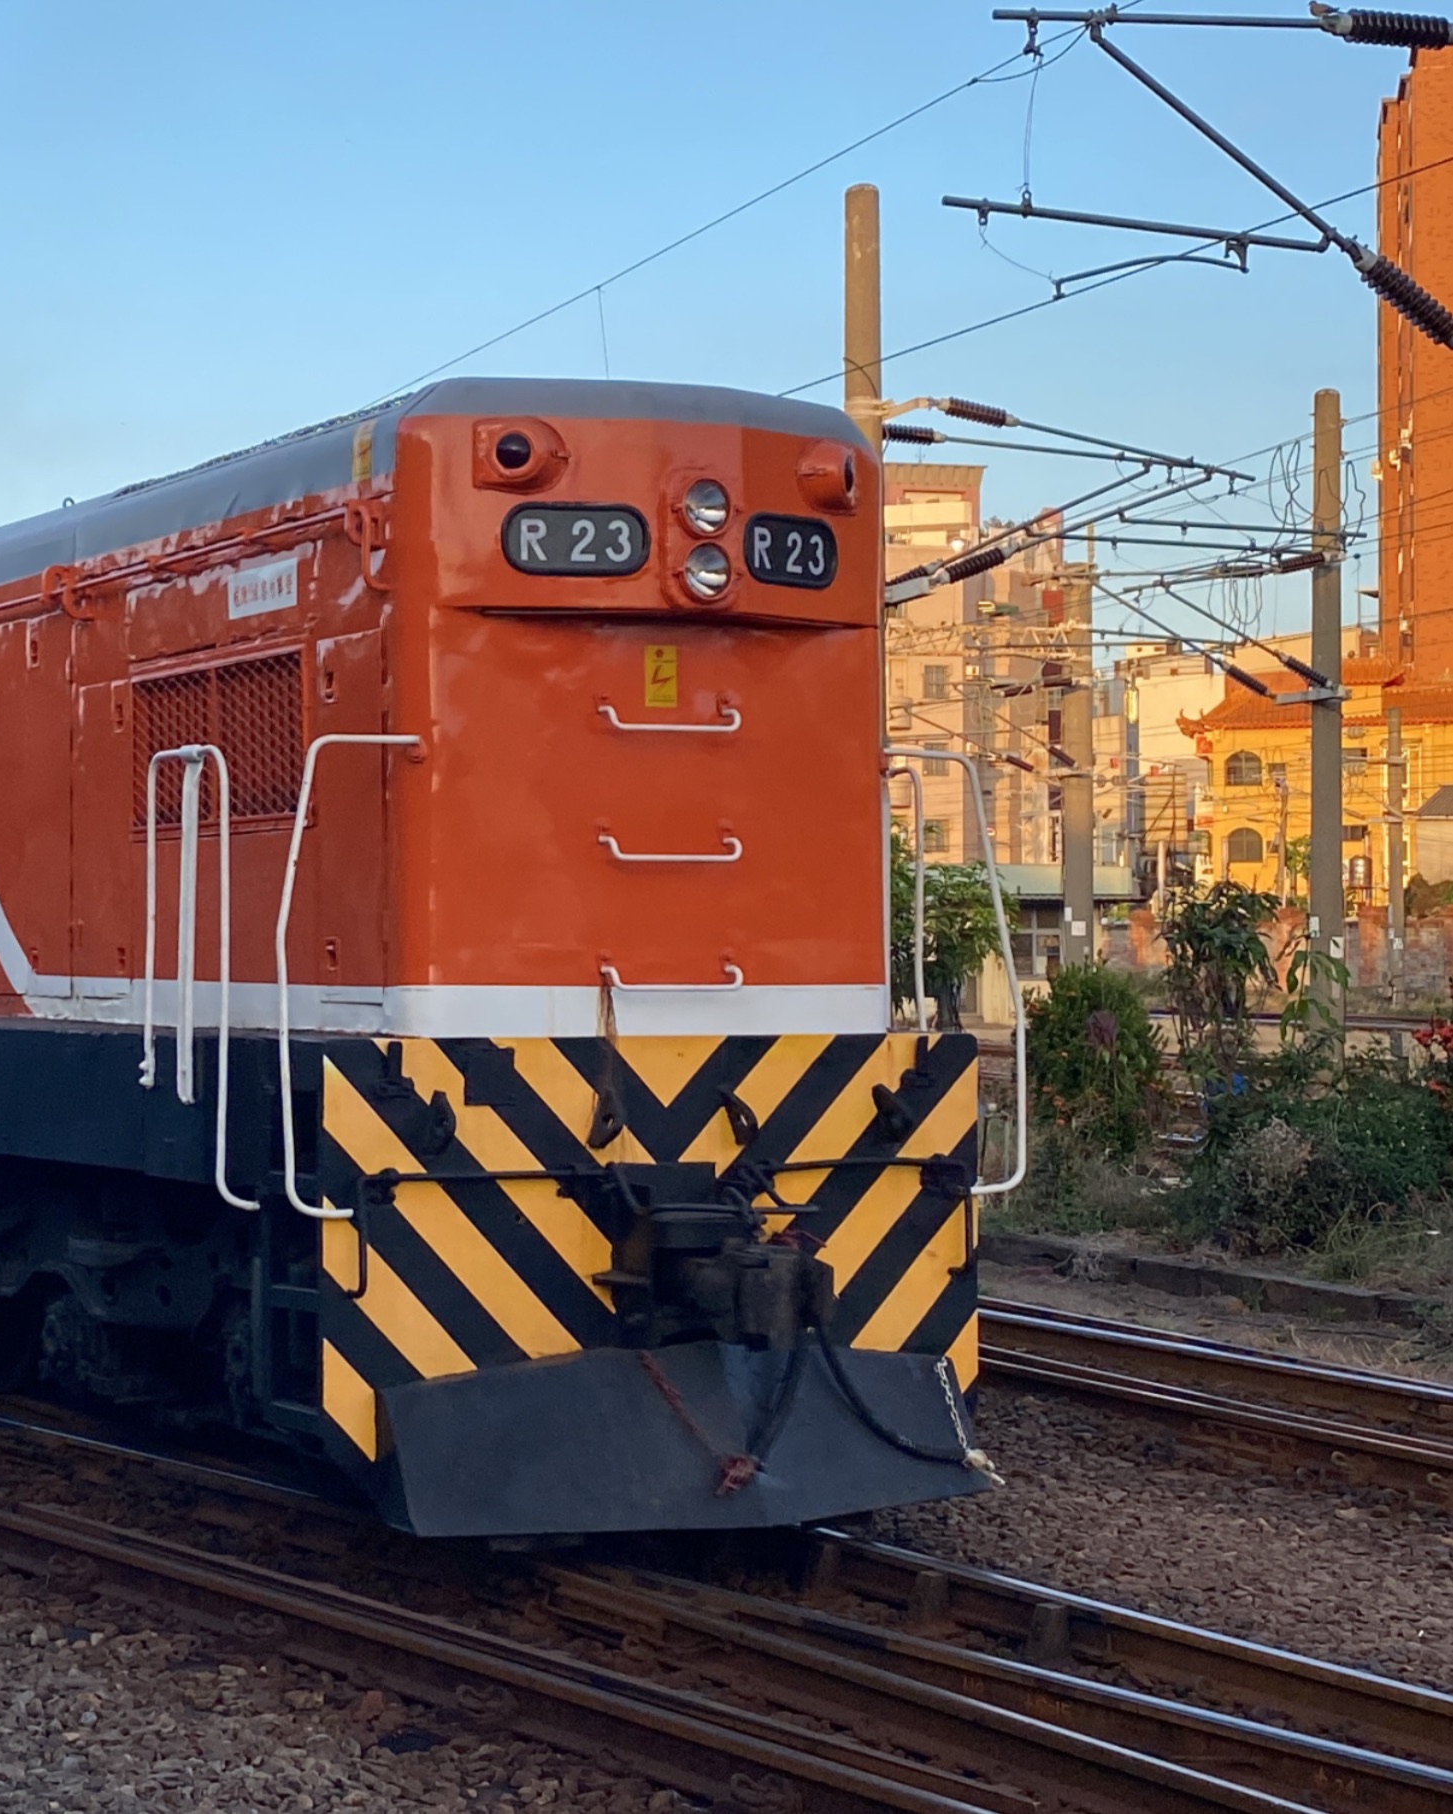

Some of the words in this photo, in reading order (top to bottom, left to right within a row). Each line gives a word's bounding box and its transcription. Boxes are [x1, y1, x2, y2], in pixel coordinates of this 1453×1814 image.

[519, 518, 548, 562] R
[570, 518, 632, 563] 23
[753, 526, 773, 570] R
[785, 531, 825, 576] 23
